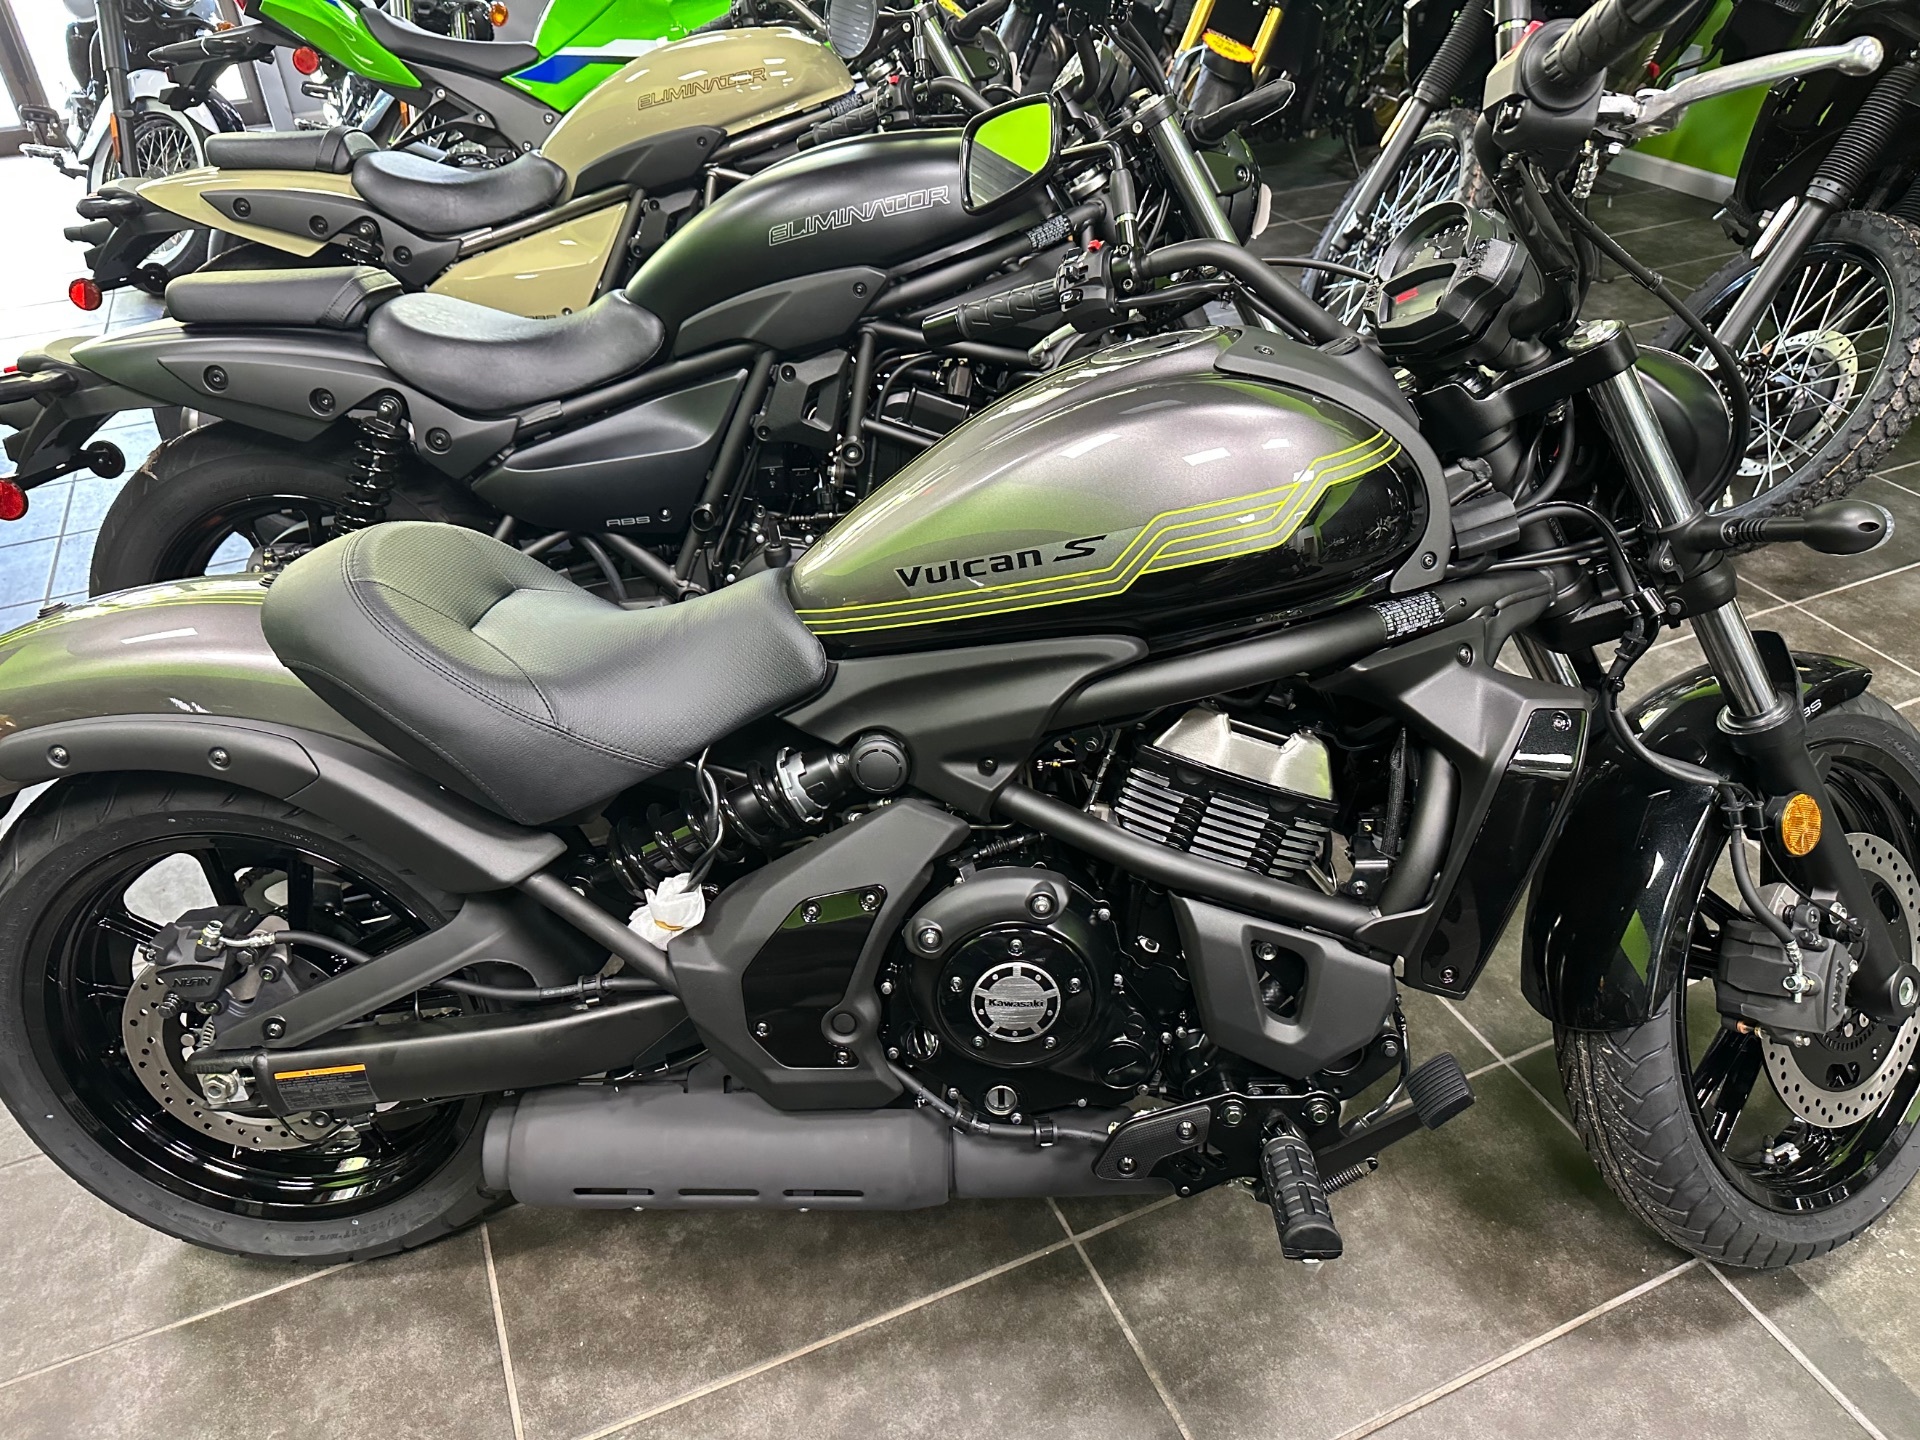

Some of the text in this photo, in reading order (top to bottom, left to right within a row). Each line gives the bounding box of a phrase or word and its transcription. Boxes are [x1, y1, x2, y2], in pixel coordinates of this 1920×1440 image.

[638, 67, 767, 110] ELIMINATOR
[768, 185, 950, 246] ELIMINATOR
[606, 516, 650, 527] ABS
[895, 534, 1108, 587] Vulcan S
[1803, 698, 1822, 718] BS
[988, 998, 1044, 1008] Kawasaki
